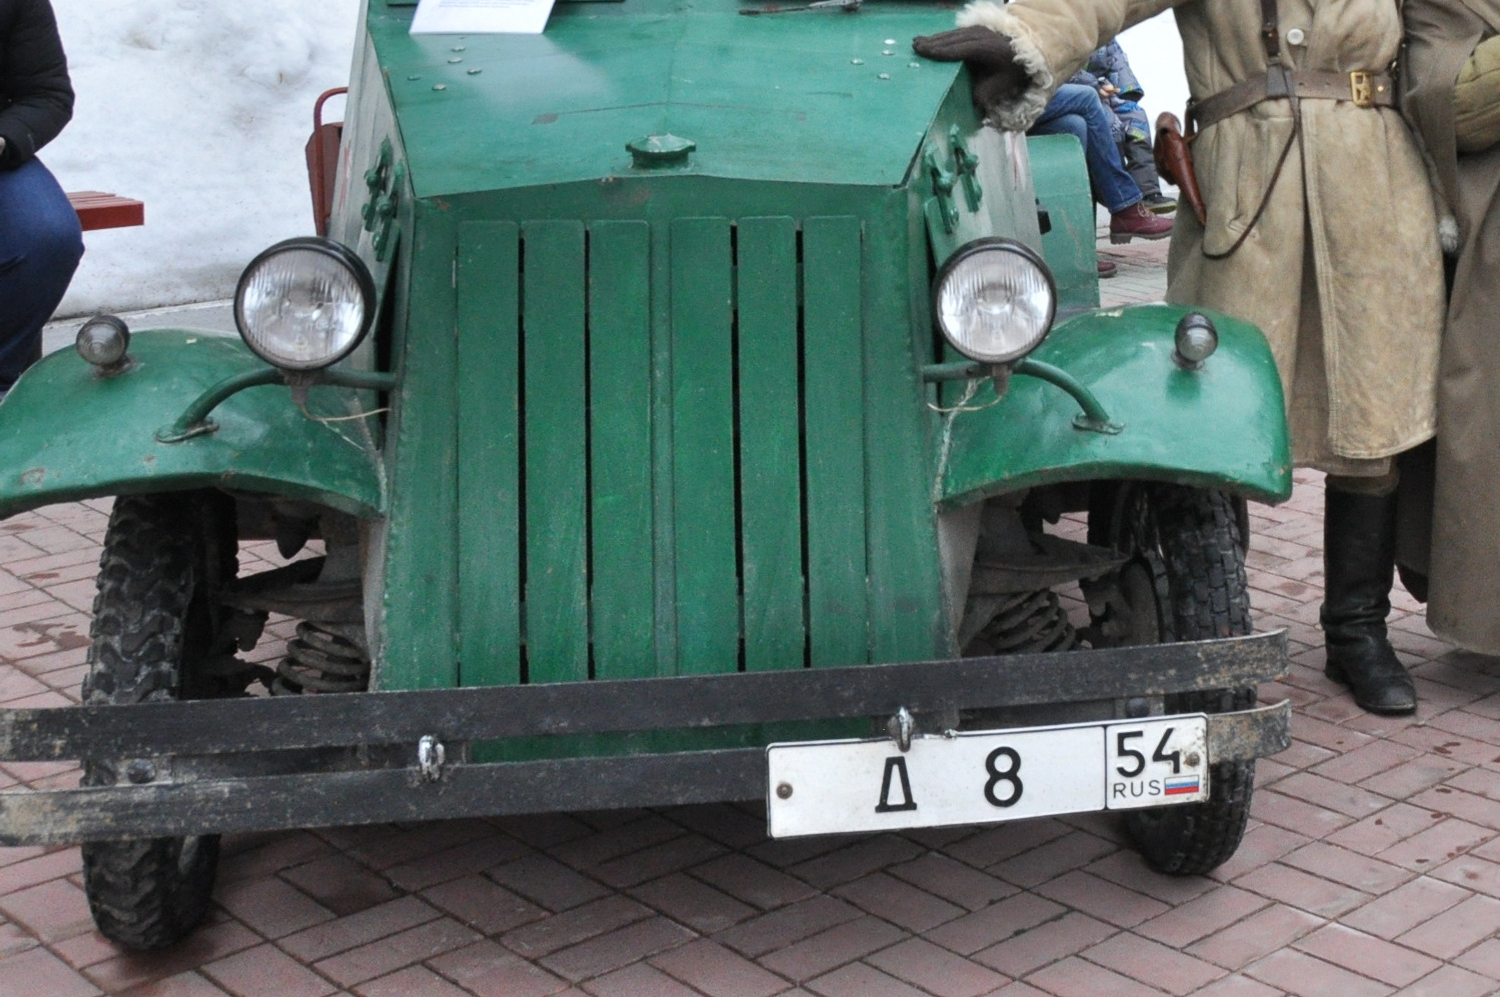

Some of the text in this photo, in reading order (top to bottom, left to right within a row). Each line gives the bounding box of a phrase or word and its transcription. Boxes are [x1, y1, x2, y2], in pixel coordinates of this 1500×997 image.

[1116, 727, 1181, 778] 54
[875, 746, 1024, 813] Д 8
[1113, 779, 1161, 799] RUS
